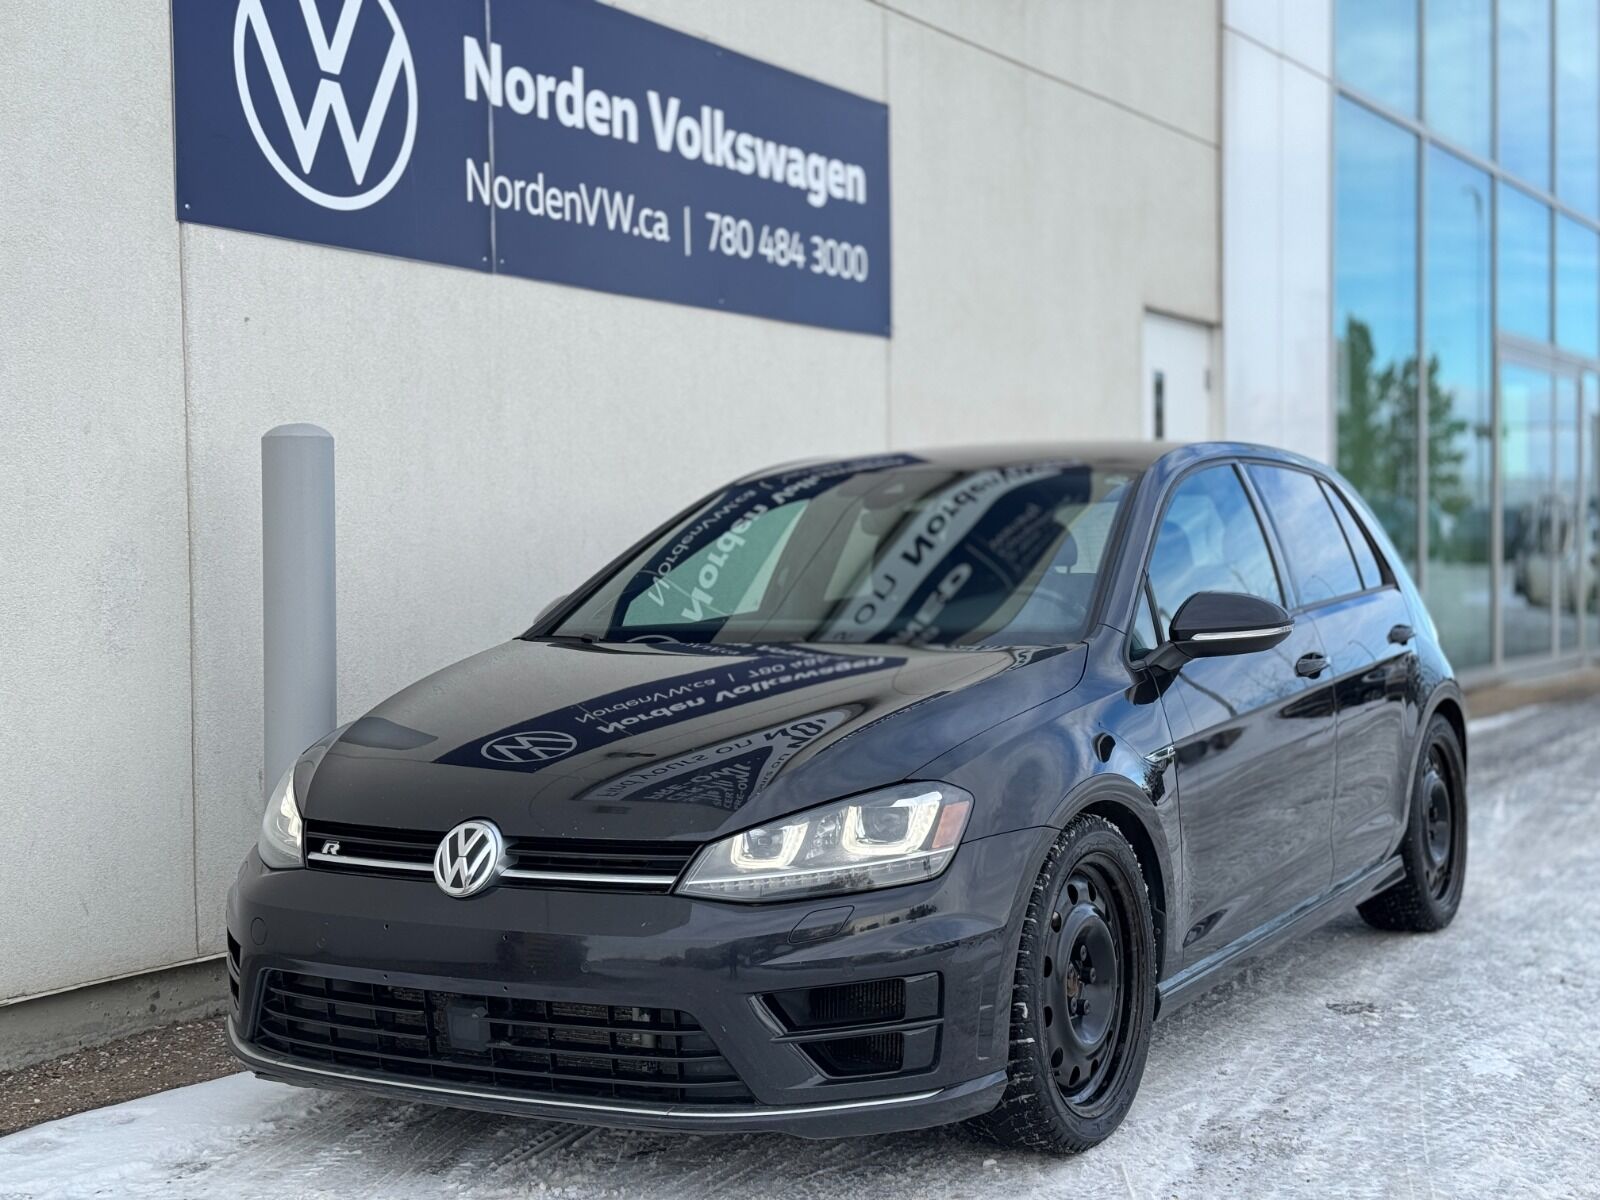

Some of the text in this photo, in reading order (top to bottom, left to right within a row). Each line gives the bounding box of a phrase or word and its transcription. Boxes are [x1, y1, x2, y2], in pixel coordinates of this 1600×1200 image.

[463, 34, 868, 208] Norden Volkswagen
[465, 157, 671, 243] NordenVW.ca
[705, 211, 755, 260] 780
[757, 224, 807, 270] 484
[809, 235, 869, 283] 3000
[320, 839, 341, 857] R
[434, 821, 499, 898] VW
